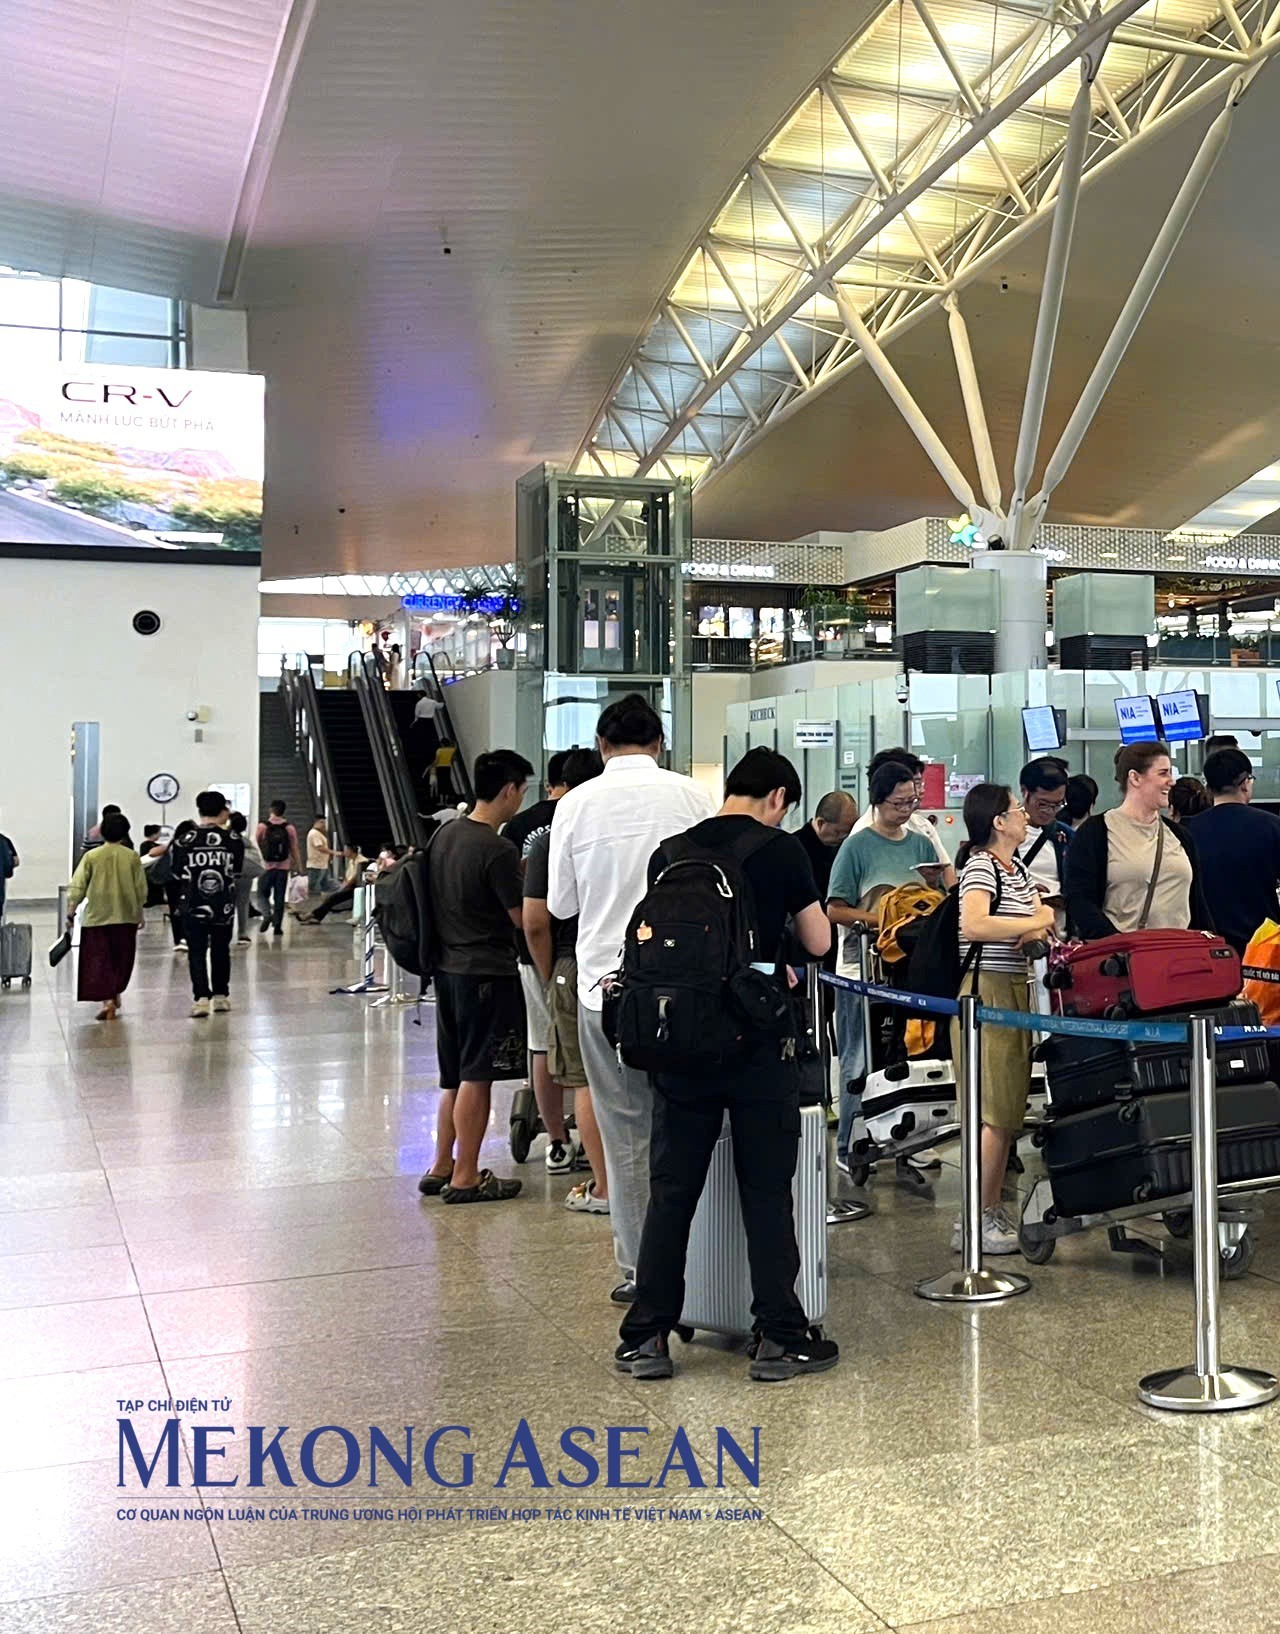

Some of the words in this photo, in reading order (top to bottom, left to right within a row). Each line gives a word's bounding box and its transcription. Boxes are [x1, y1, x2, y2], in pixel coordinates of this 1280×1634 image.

[61, 382, 193, 408] CR-V
[681, 562, 719, 576] FOOD
[1205, 555, 1238, 569] FOOD
[1120, 706, 1137, 720] NIA
[1162, 702, 1180, 717] NIA
